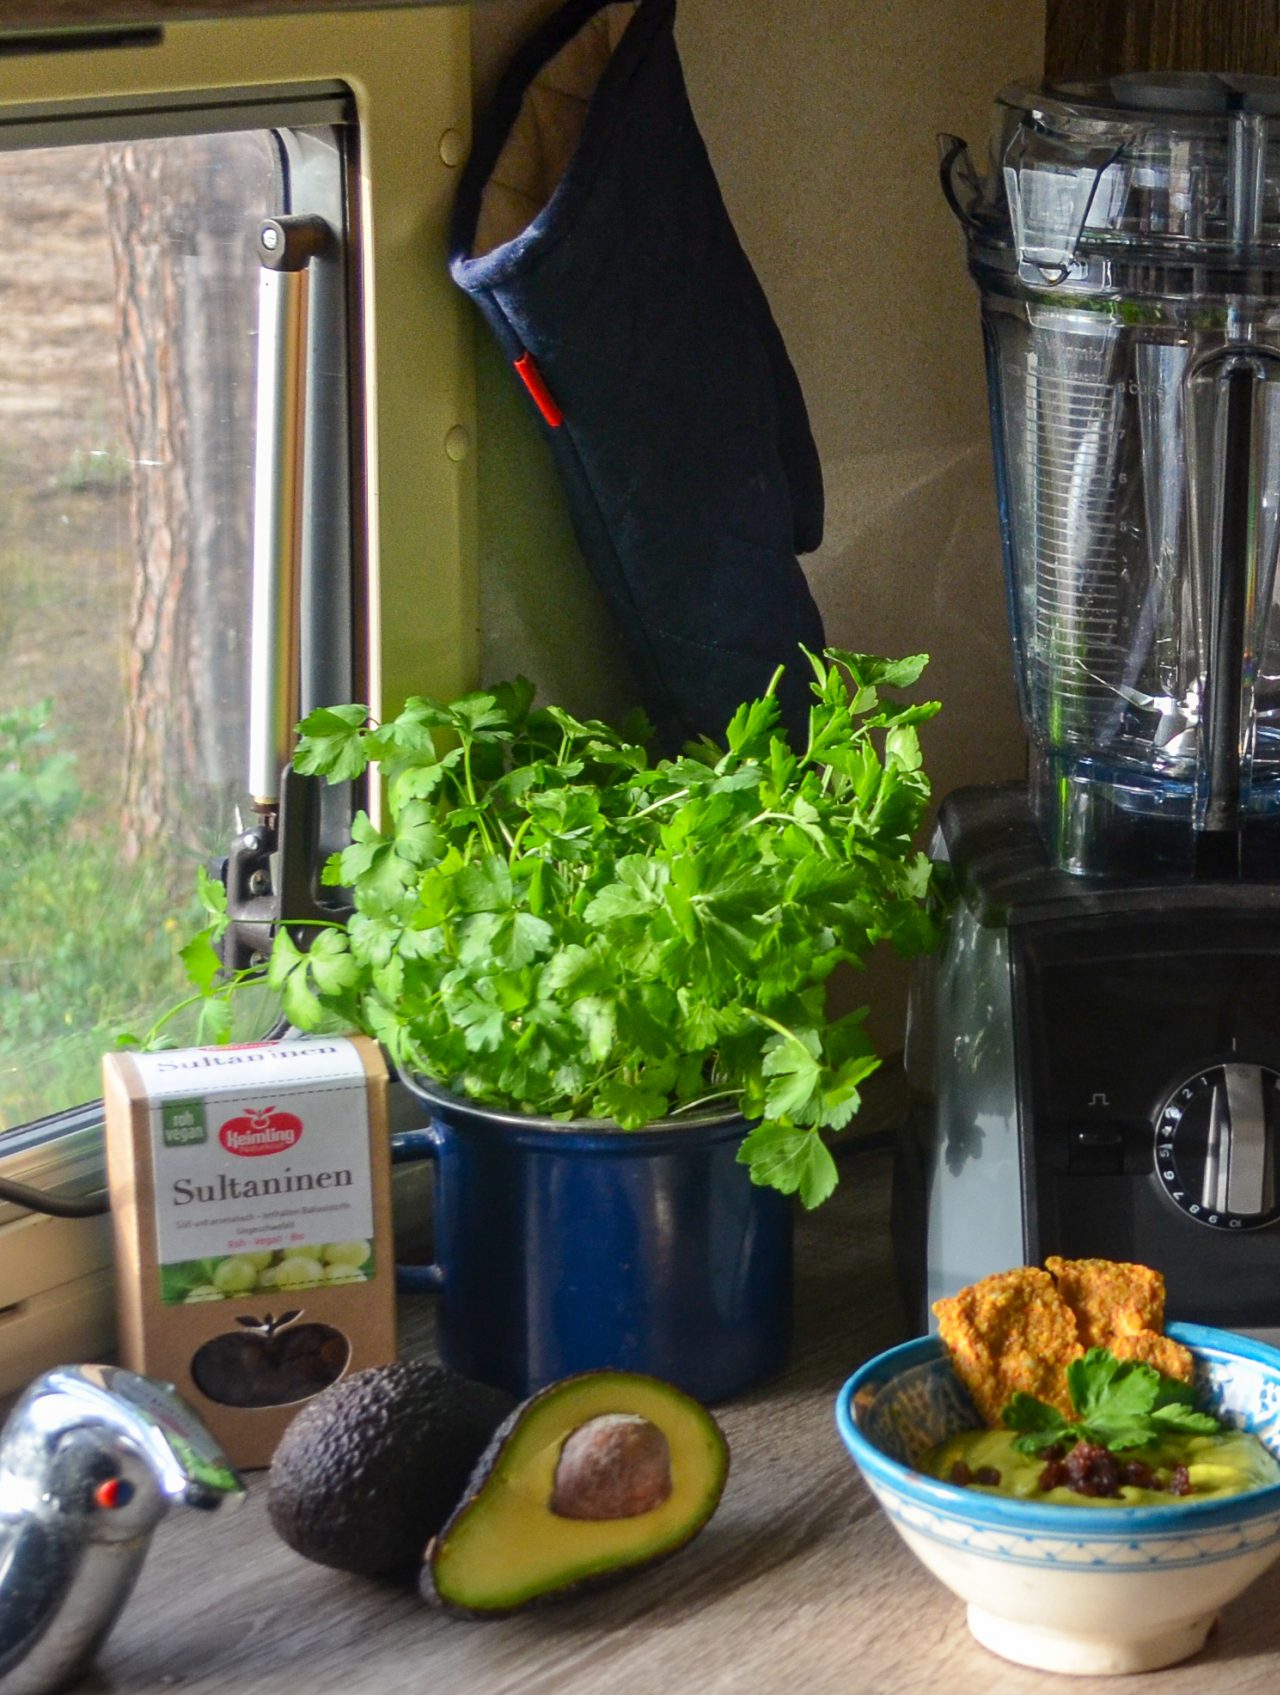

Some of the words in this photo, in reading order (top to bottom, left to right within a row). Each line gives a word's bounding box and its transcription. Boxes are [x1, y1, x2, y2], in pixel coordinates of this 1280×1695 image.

[1118, 472, 1128, 483] 6
[1181, 1088, 1194, 1100] 2
[172, 1110, 195, 1127] roh
[165, 1126, 204, 1142] vegan
[1159, 1148, 1171, 1158] 5
[1163, 1170, 1175, 1181] 6
[172, 1167, 354, 1207] Sultaninen
[1172, 1190, 1185, 1201] 7
[1189, 1203, 1201, 1215] 8
[1208, 1215, 1219, 1225] 9
[1228, 1218, 1243, 1228] 10
